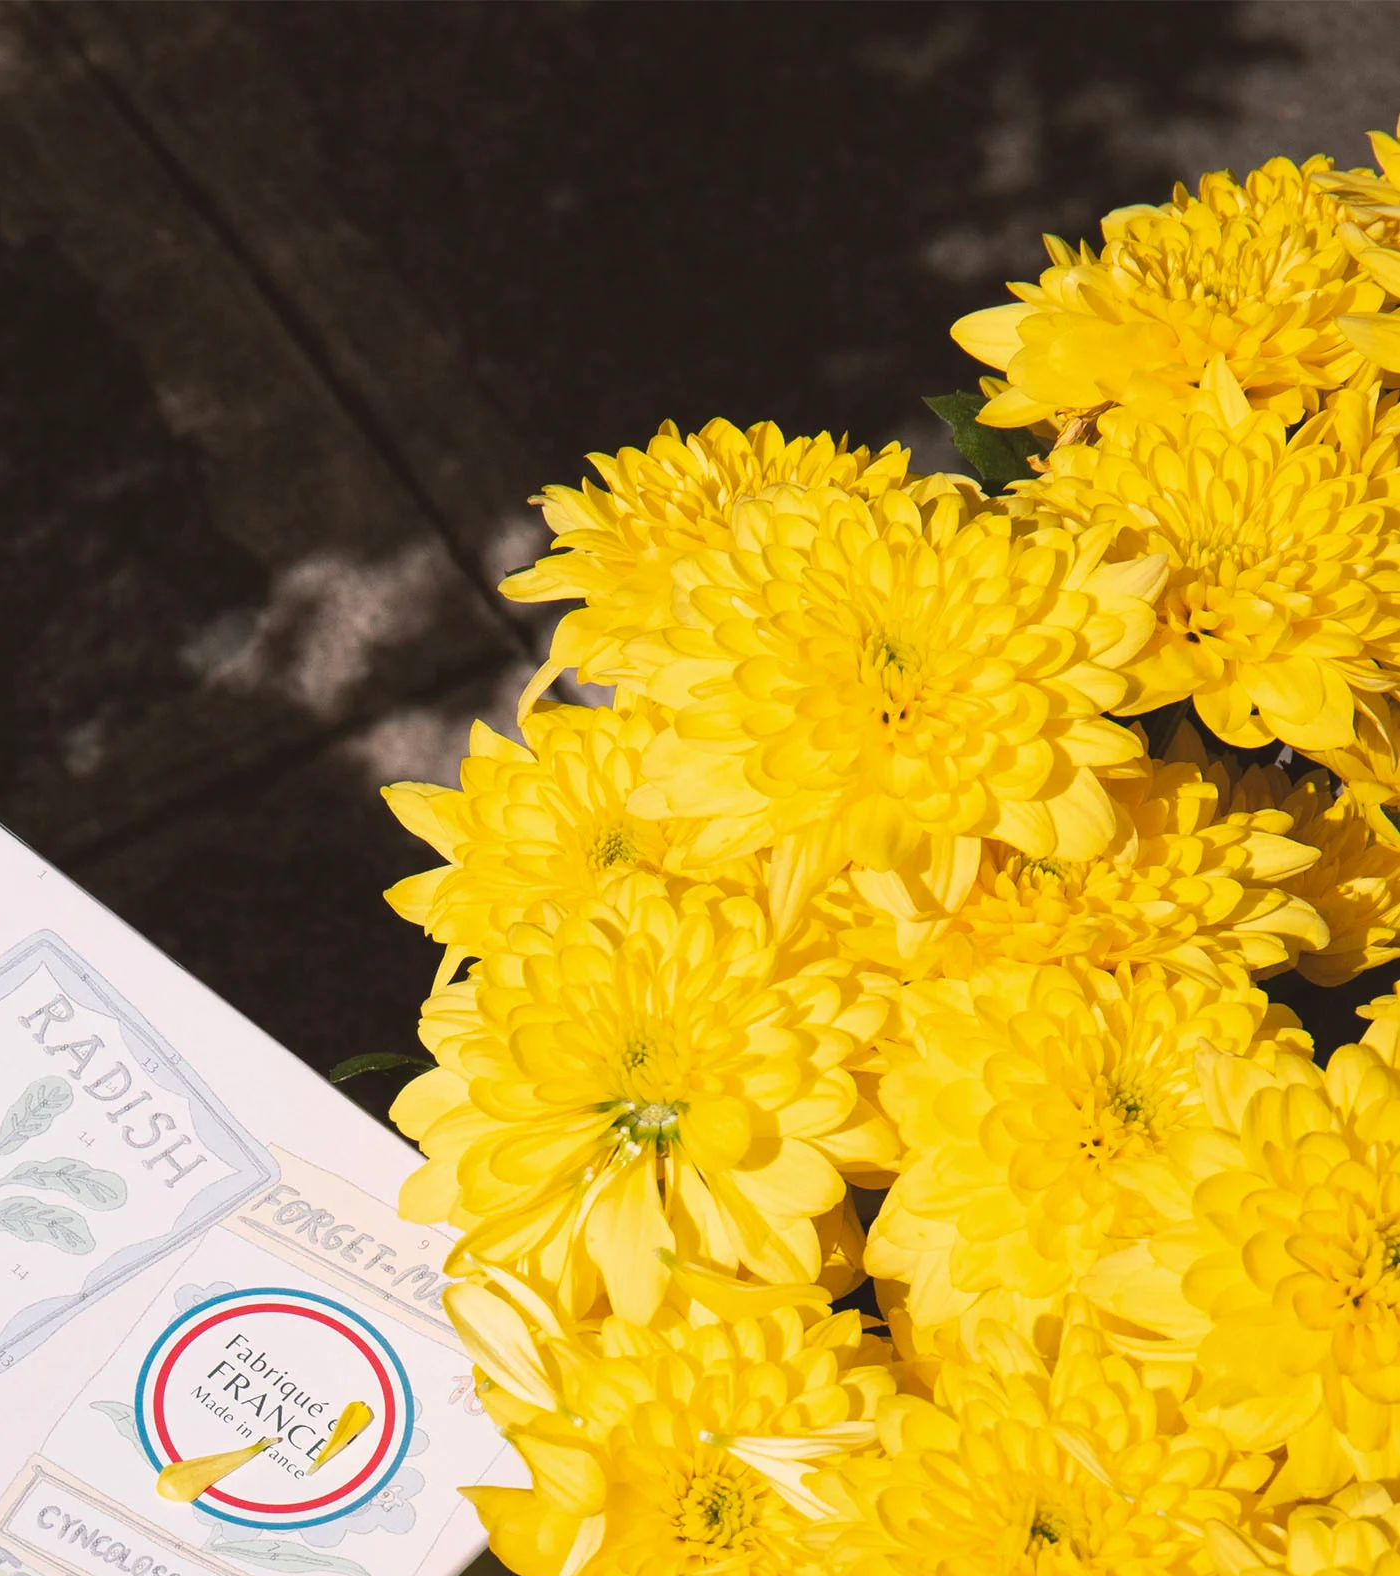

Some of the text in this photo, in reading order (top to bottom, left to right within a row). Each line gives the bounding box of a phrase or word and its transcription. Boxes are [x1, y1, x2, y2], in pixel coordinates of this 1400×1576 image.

[17, 993, 208, 1188] RADISH
[191, 1385, 234, 1424] Made
[236, 1420, 253, 1439] in
[207, 1360, 327, 1463] FRANCE
[225, 1334, 330, 1418] Fabriqué
